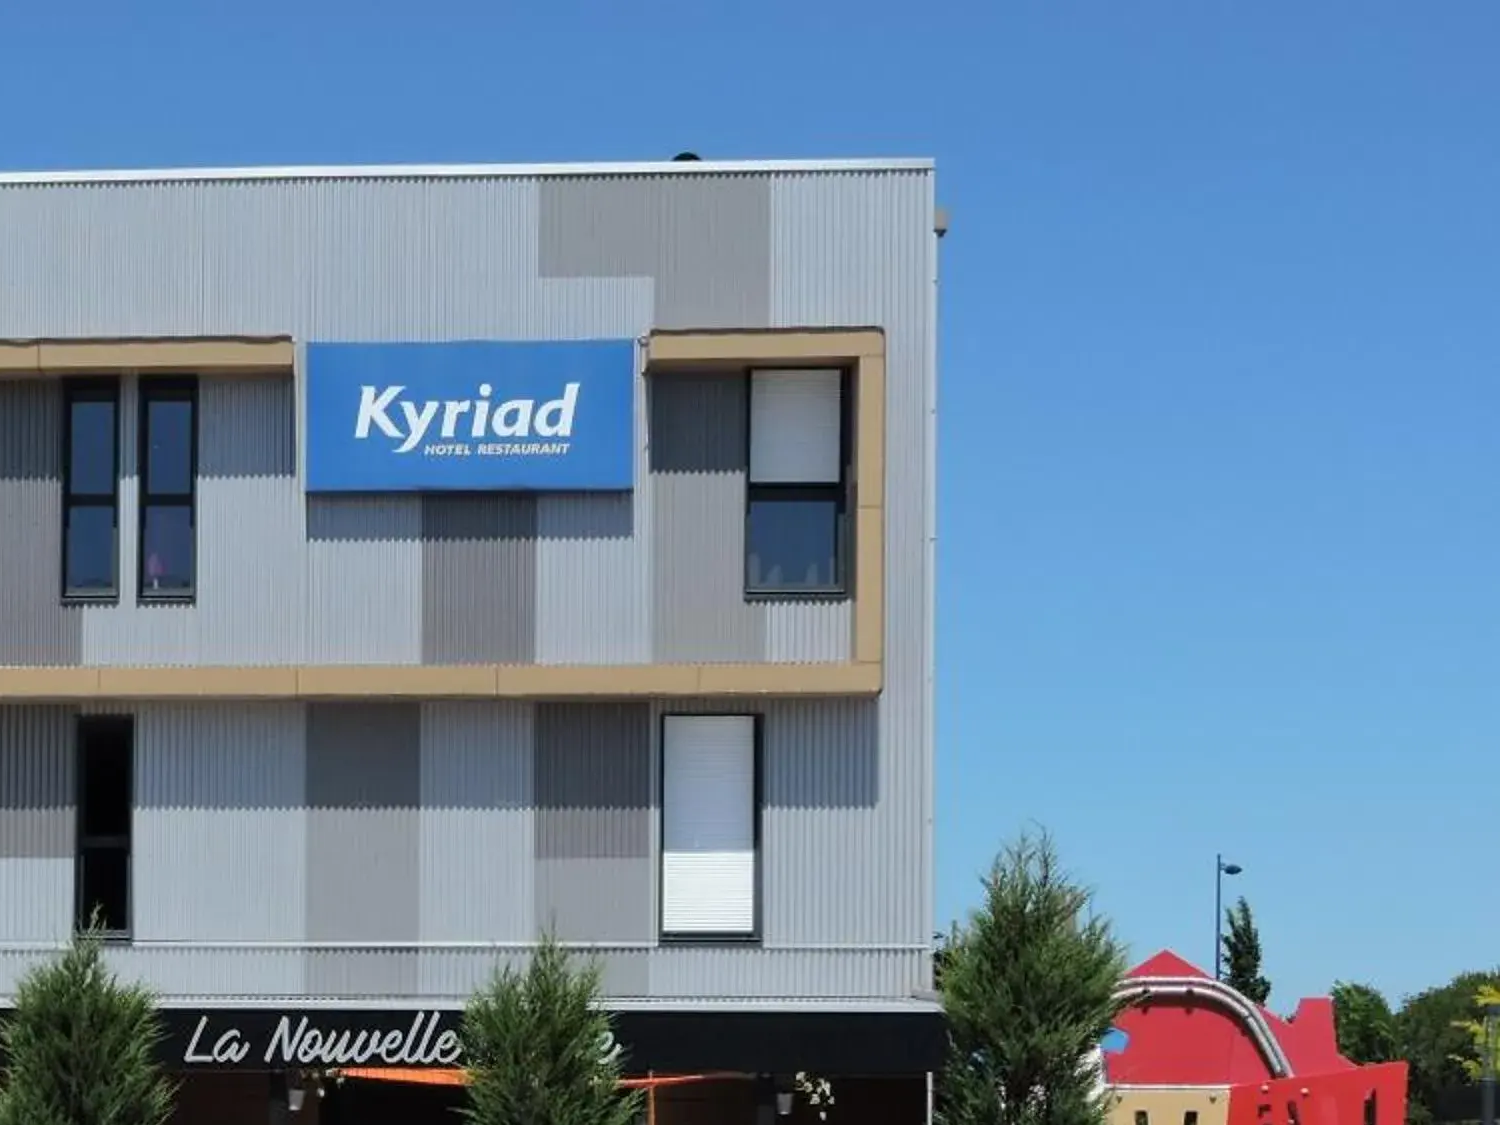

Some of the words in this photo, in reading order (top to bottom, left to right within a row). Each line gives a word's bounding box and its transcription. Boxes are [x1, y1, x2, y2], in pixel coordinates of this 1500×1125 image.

[355, 383, 581, 453] Kyriad
[424, 444, 471, 455] HOTEL
[477, 443, 570, 455] RESTAURANT
[184, 1015, 251, 1063] La
[263, 1010, 463, 1064] Nouvelle
